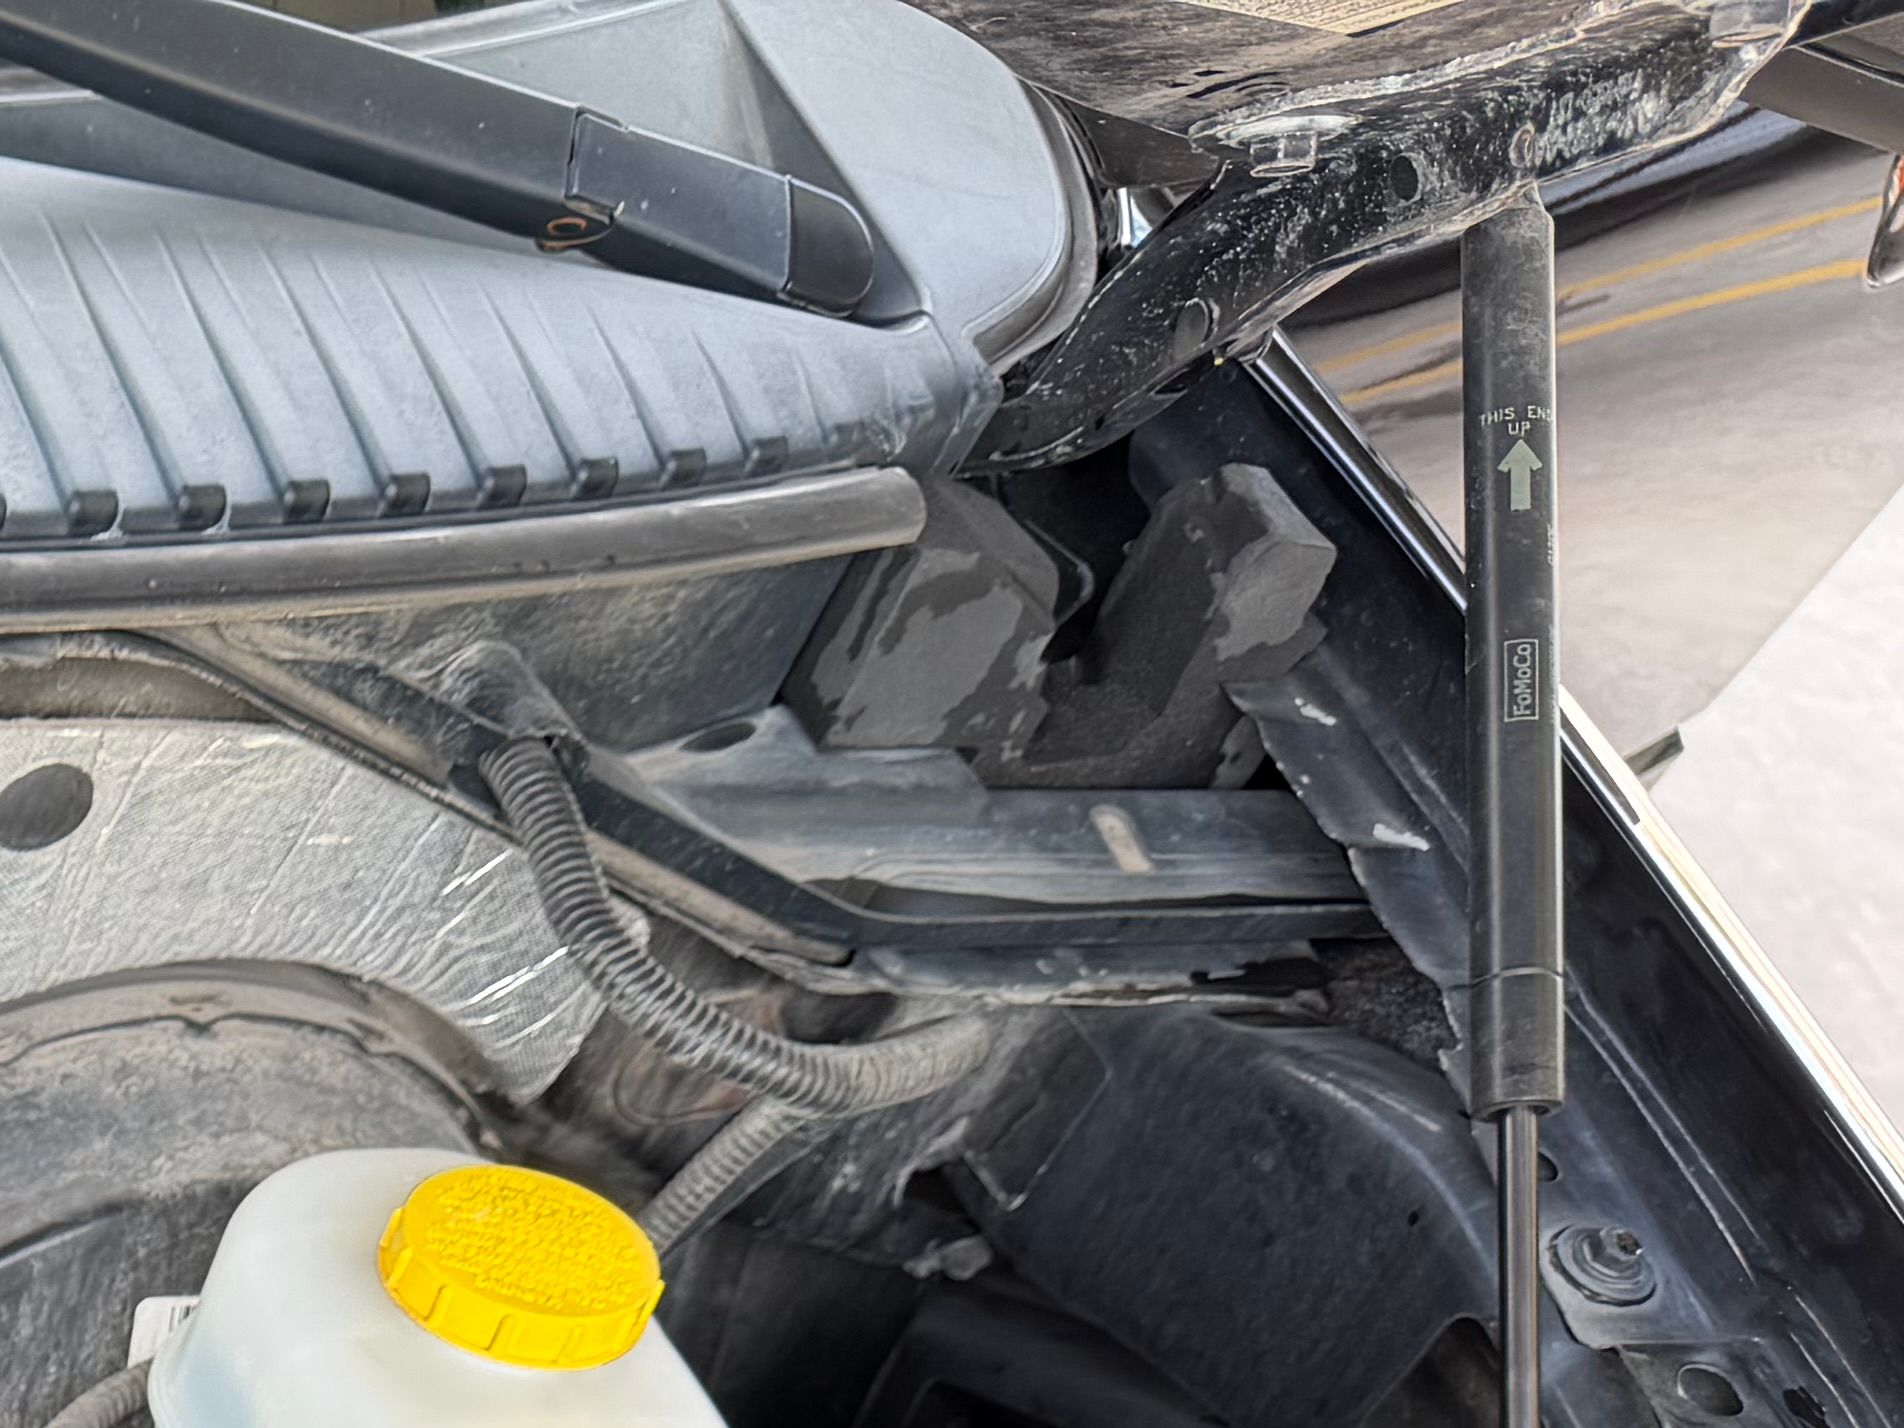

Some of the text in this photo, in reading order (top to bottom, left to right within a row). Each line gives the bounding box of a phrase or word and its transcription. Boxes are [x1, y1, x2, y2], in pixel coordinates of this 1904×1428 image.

[1480, 405, 1515, 426] THIS
[1508, 421, 1531, 436] UP
[1515, 644, 1533, 717] FoMoCo
